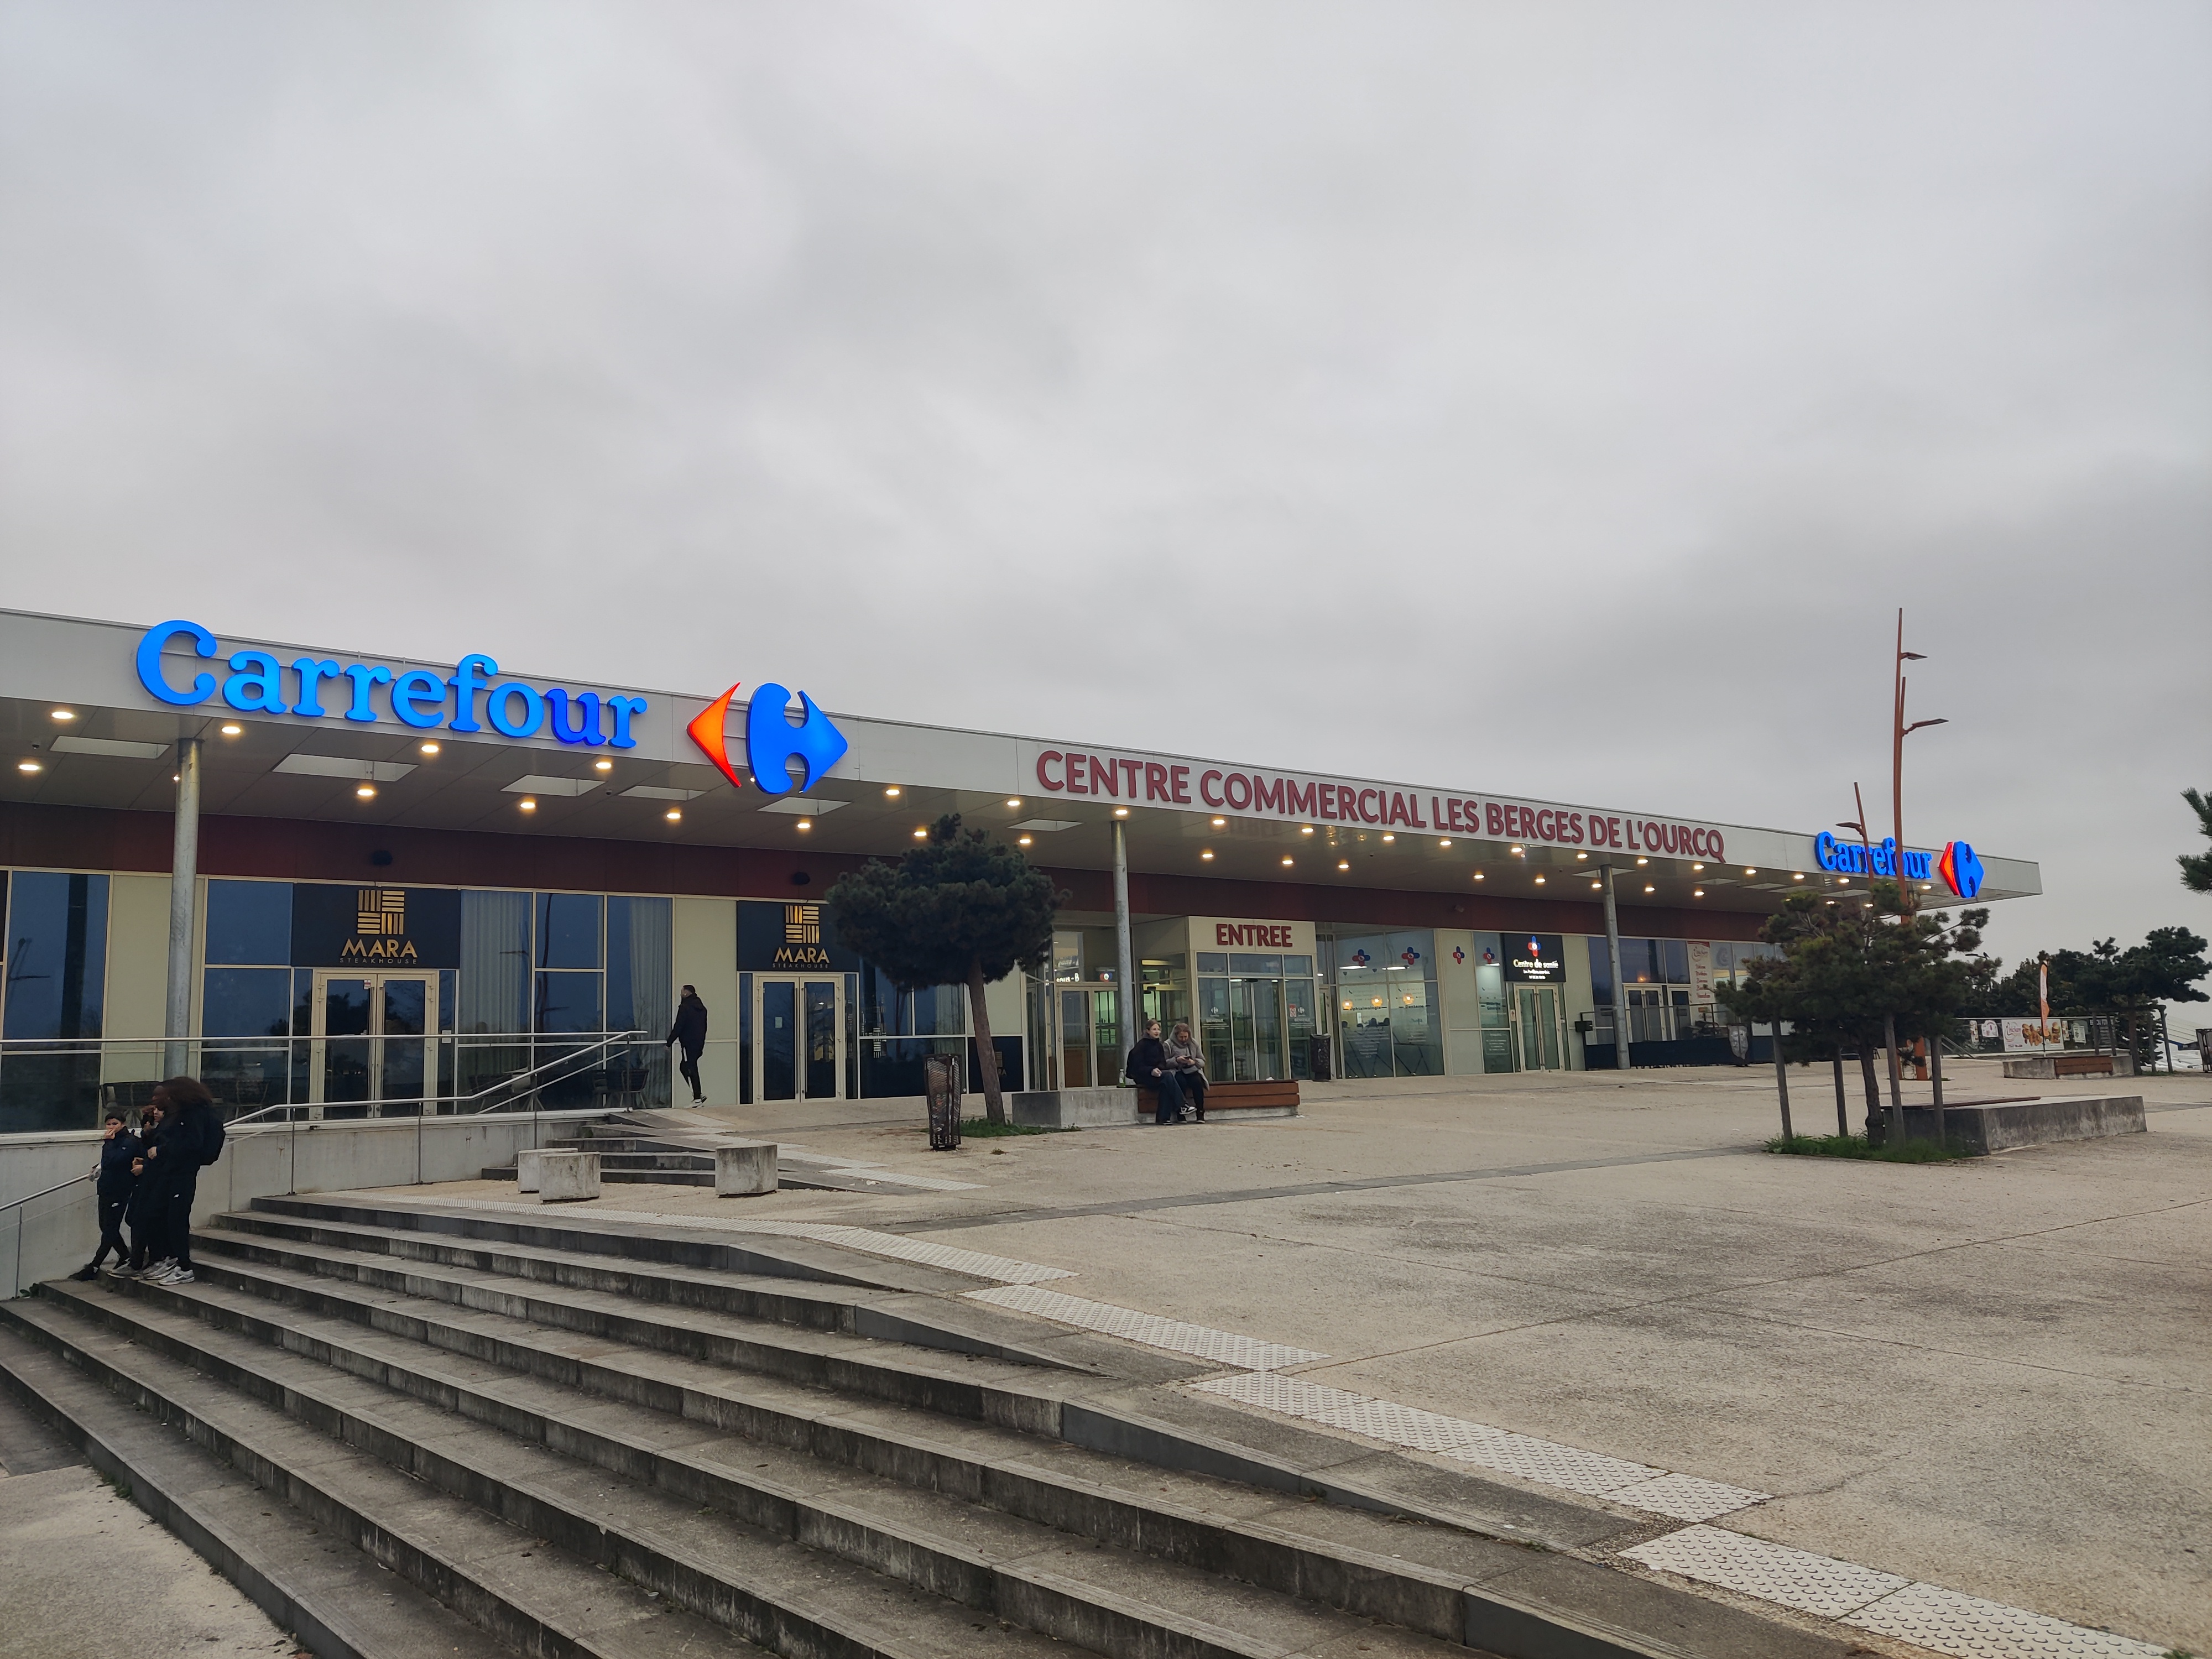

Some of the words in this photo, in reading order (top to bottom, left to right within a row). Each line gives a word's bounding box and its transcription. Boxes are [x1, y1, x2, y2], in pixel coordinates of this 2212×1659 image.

[137, 620, 648, 748] Carrefour
[1037, 750, 1191, 804] CENTRE
[1201, 770, 1427, 828] COMMERCIAL
[1433, 796, 1479, 833] LES
[1486, 803, 1584, 843] BERGES
[1589, 815, 1622, 848] DE
[1627, 820, 1726, 863] L'OURCQ
[1216, 923, 1293, 947] ENTREE
[341, 938, 418, 958] MARA
[774, 947, 830, 963] MARA
[1513, 959, 1533, 968] Centre
[1534, 958, 1542, 968] de
